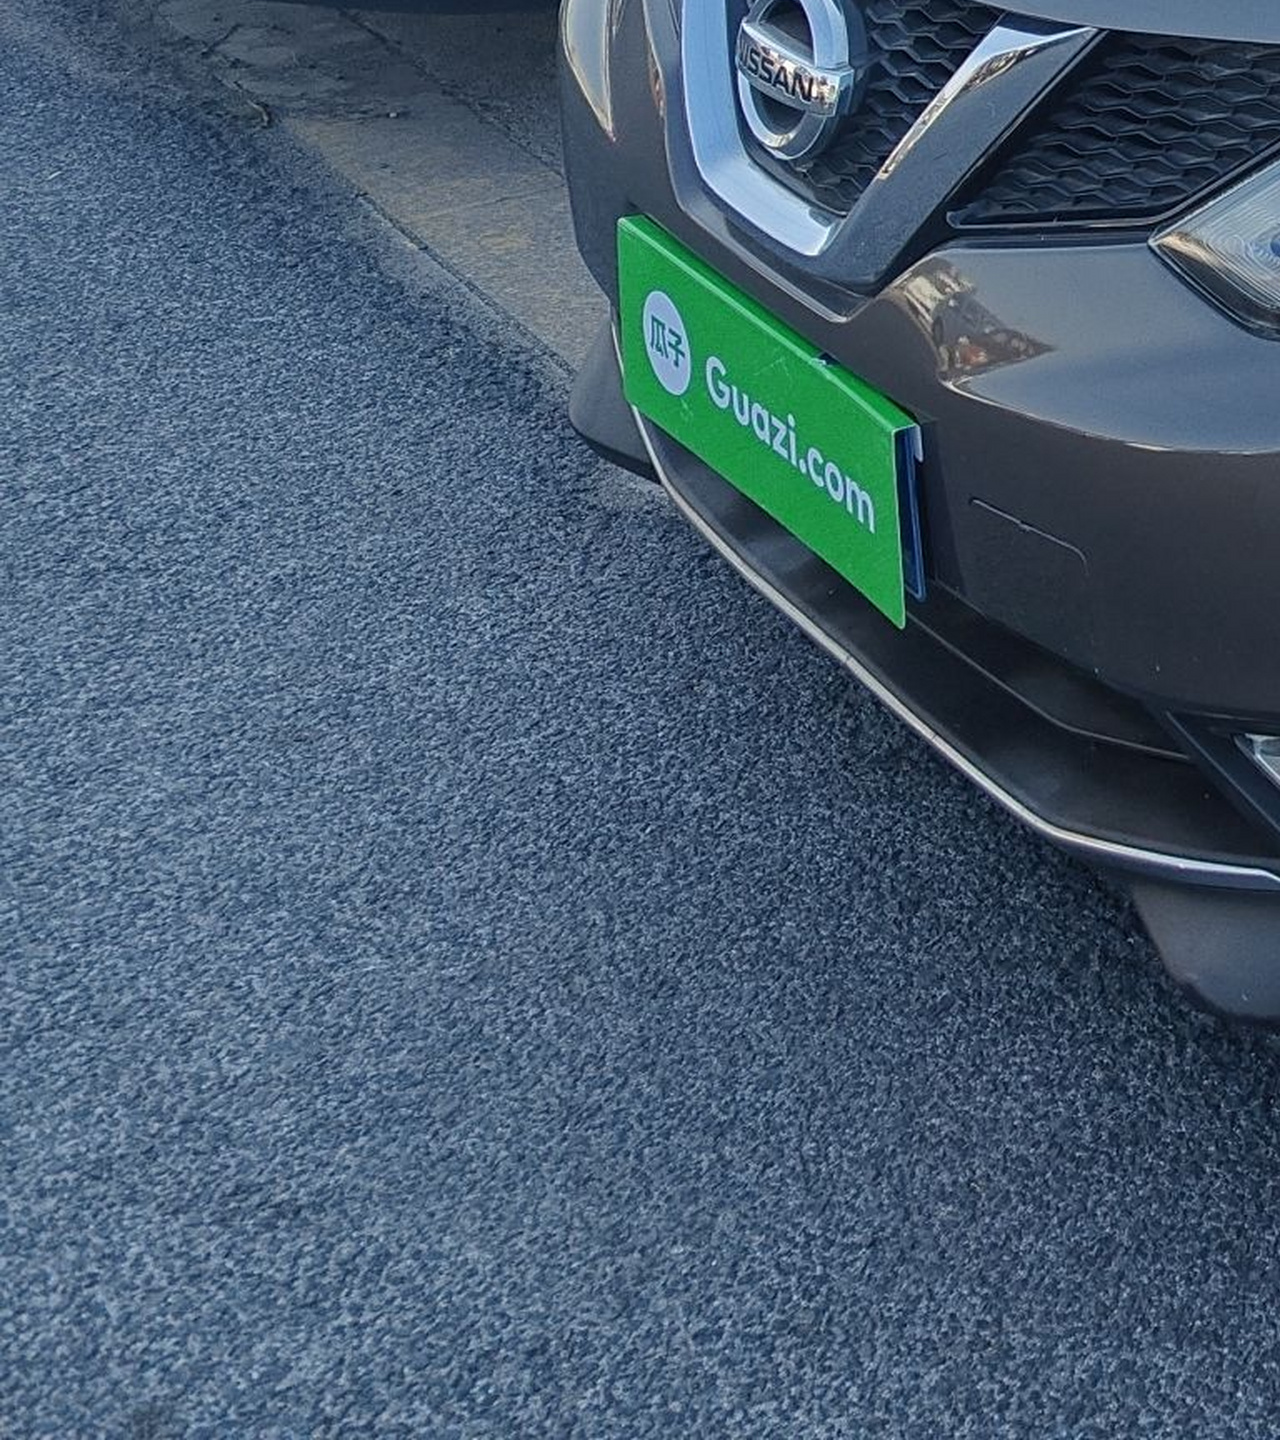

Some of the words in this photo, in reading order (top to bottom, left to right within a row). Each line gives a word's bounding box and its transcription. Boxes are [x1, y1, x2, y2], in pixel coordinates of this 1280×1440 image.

[738, 31, 814, 103] NISSAN
[649, 316, 687, 368] 瓜子
[704, 355, 876, 534] Guazi.com
